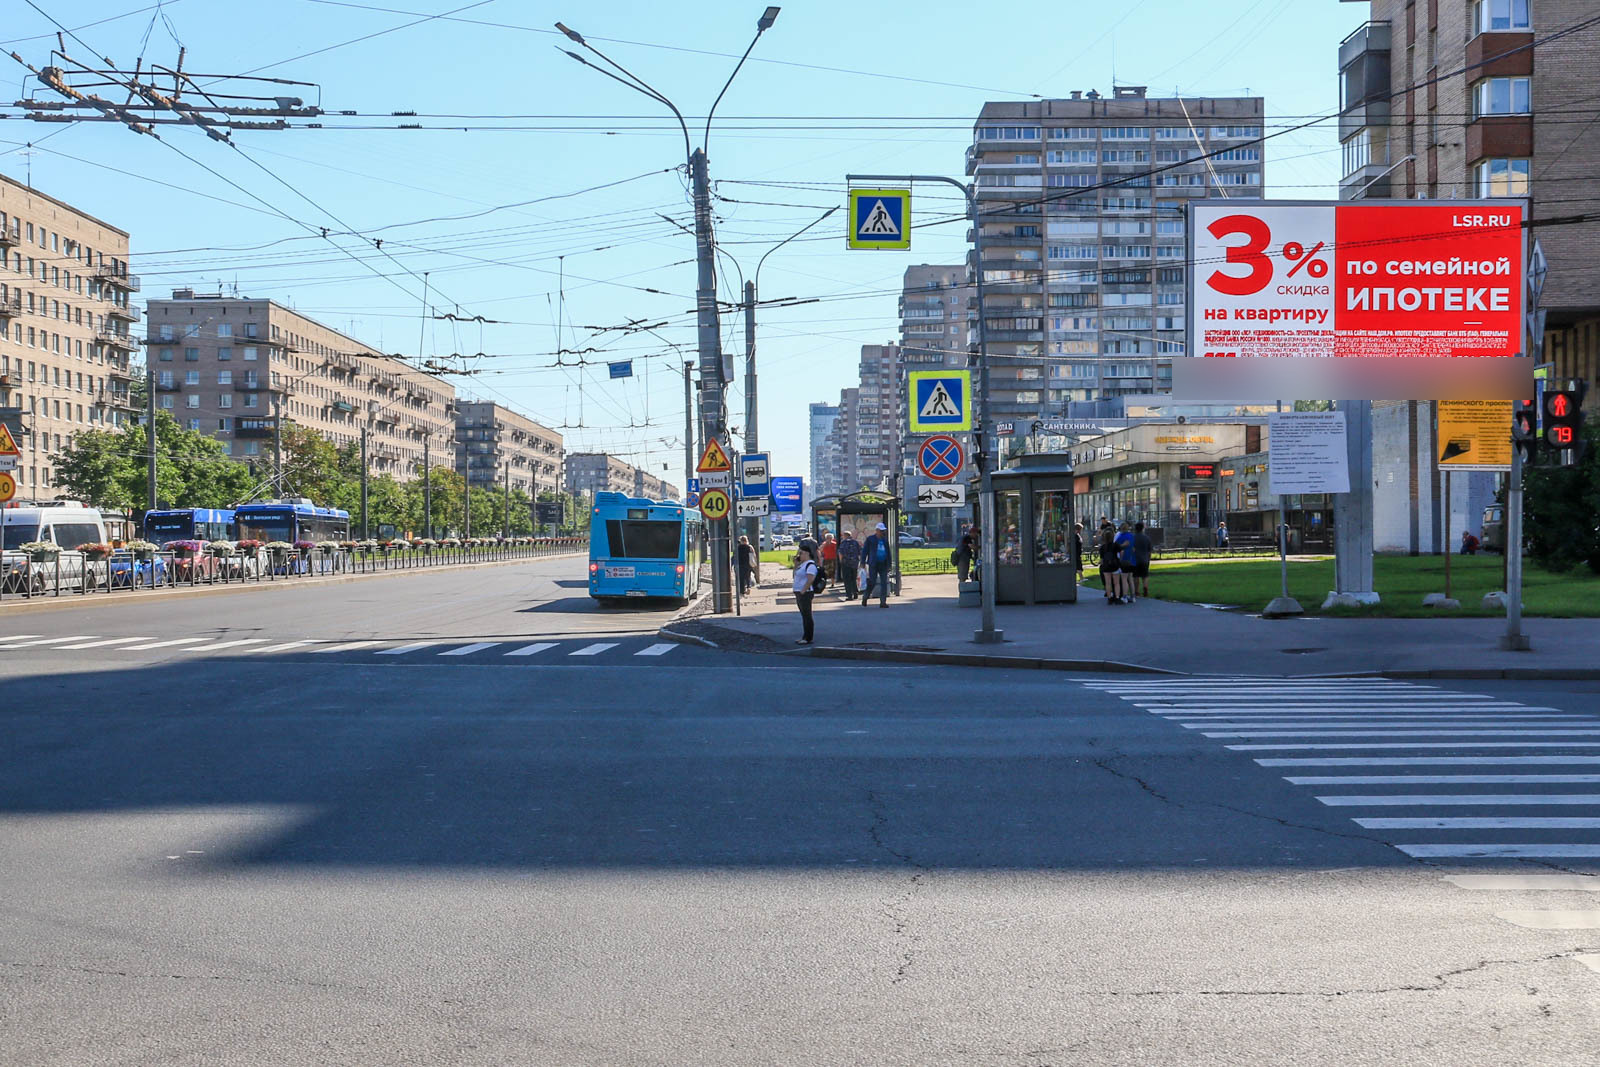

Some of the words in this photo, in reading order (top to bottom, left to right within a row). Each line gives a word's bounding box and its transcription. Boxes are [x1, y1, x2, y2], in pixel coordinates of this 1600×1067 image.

[1452, 215, 1511, 227] LSR.RU
[1206, 214, 1329, 296] 3%
[1346, 260, 1378, 275] по
[1385, 257, 1511, 275] семейной
[1276, 285, 1329, 296] скидка
[1346, 287, 1511, 311] ИПОТЕКЕ
[1204, 308, 1228, 320] на
[1234, 308, 1329, 324] квартиру
[1552, 426, 1572, 442] 79
[0, 481, 10, 494] 0
[704, 496, 725, 512] 40
